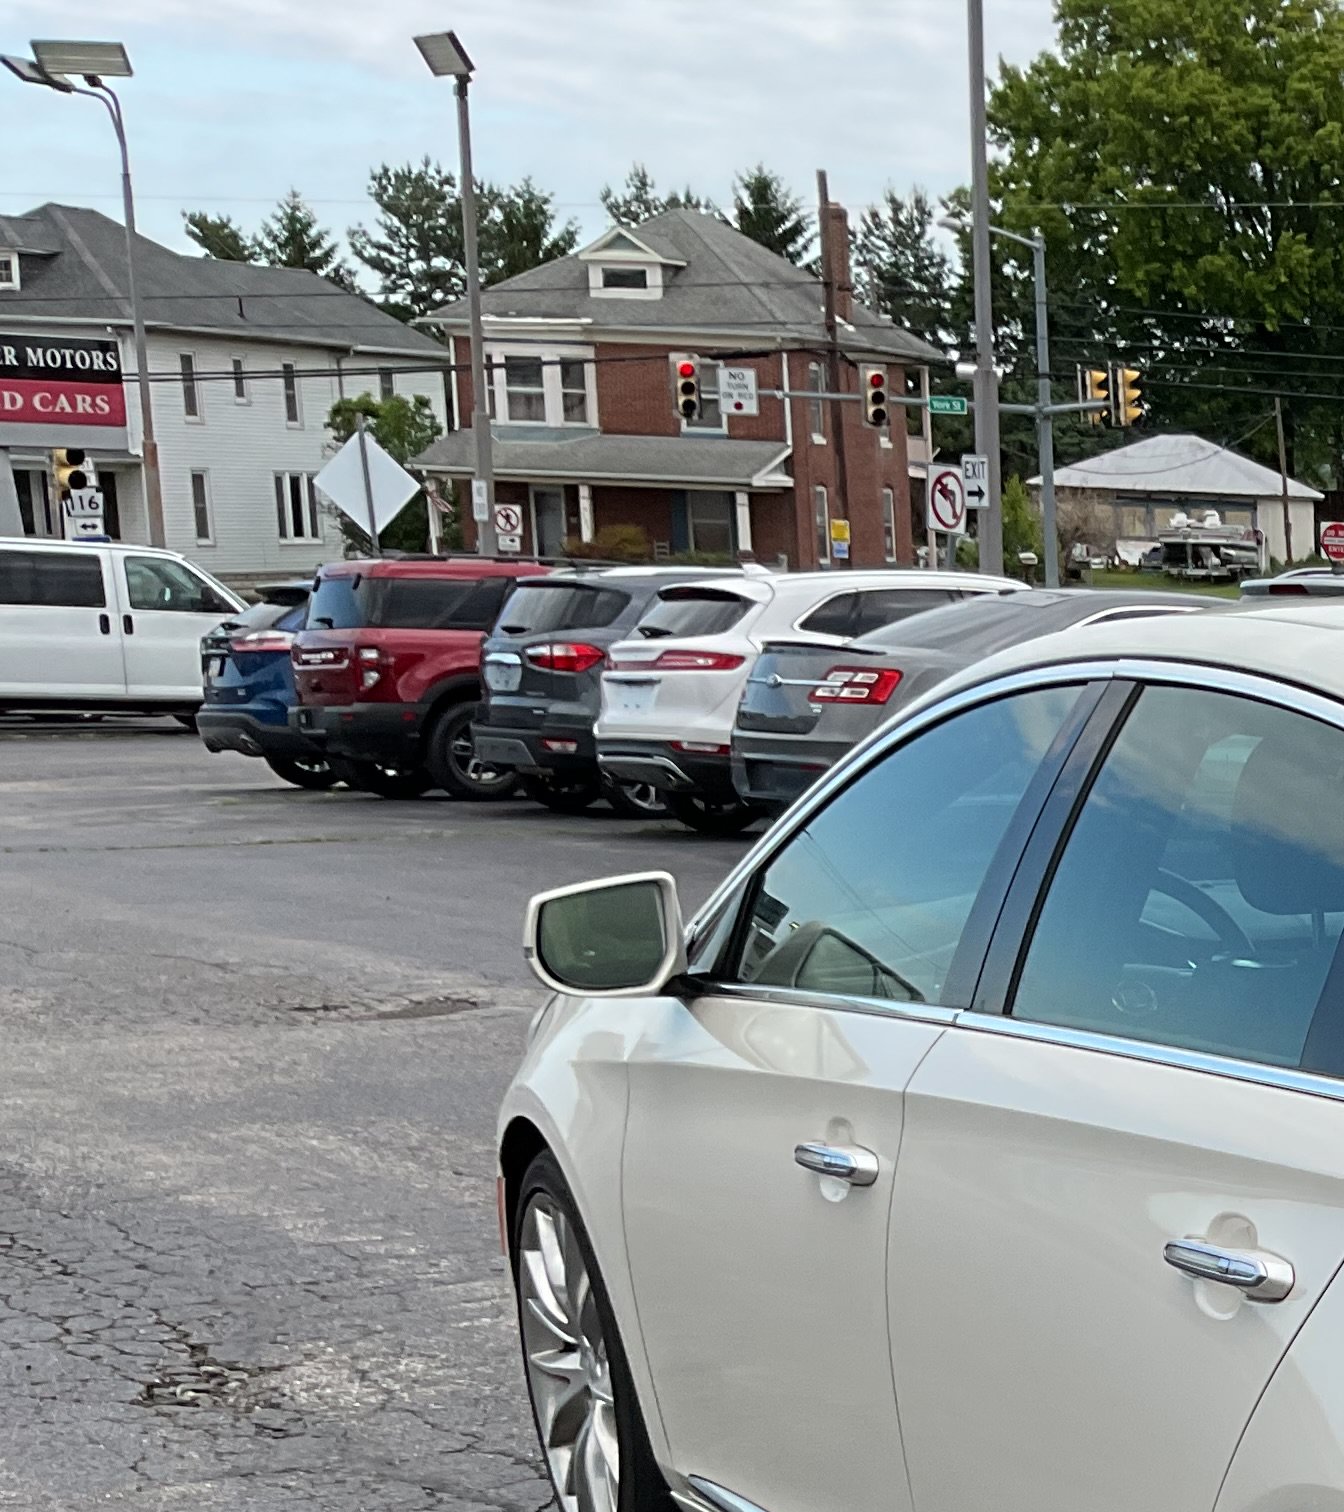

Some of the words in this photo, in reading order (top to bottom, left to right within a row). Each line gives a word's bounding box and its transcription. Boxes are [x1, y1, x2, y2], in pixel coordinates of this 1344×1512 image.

[25, 347, 118, 371] MOTORS
[728, 371, 745, 380] NO
[32, 392, 110, 415] CARS
[964, 460, 986, 480] EXIT
[70, 495, 100, 511] 116
